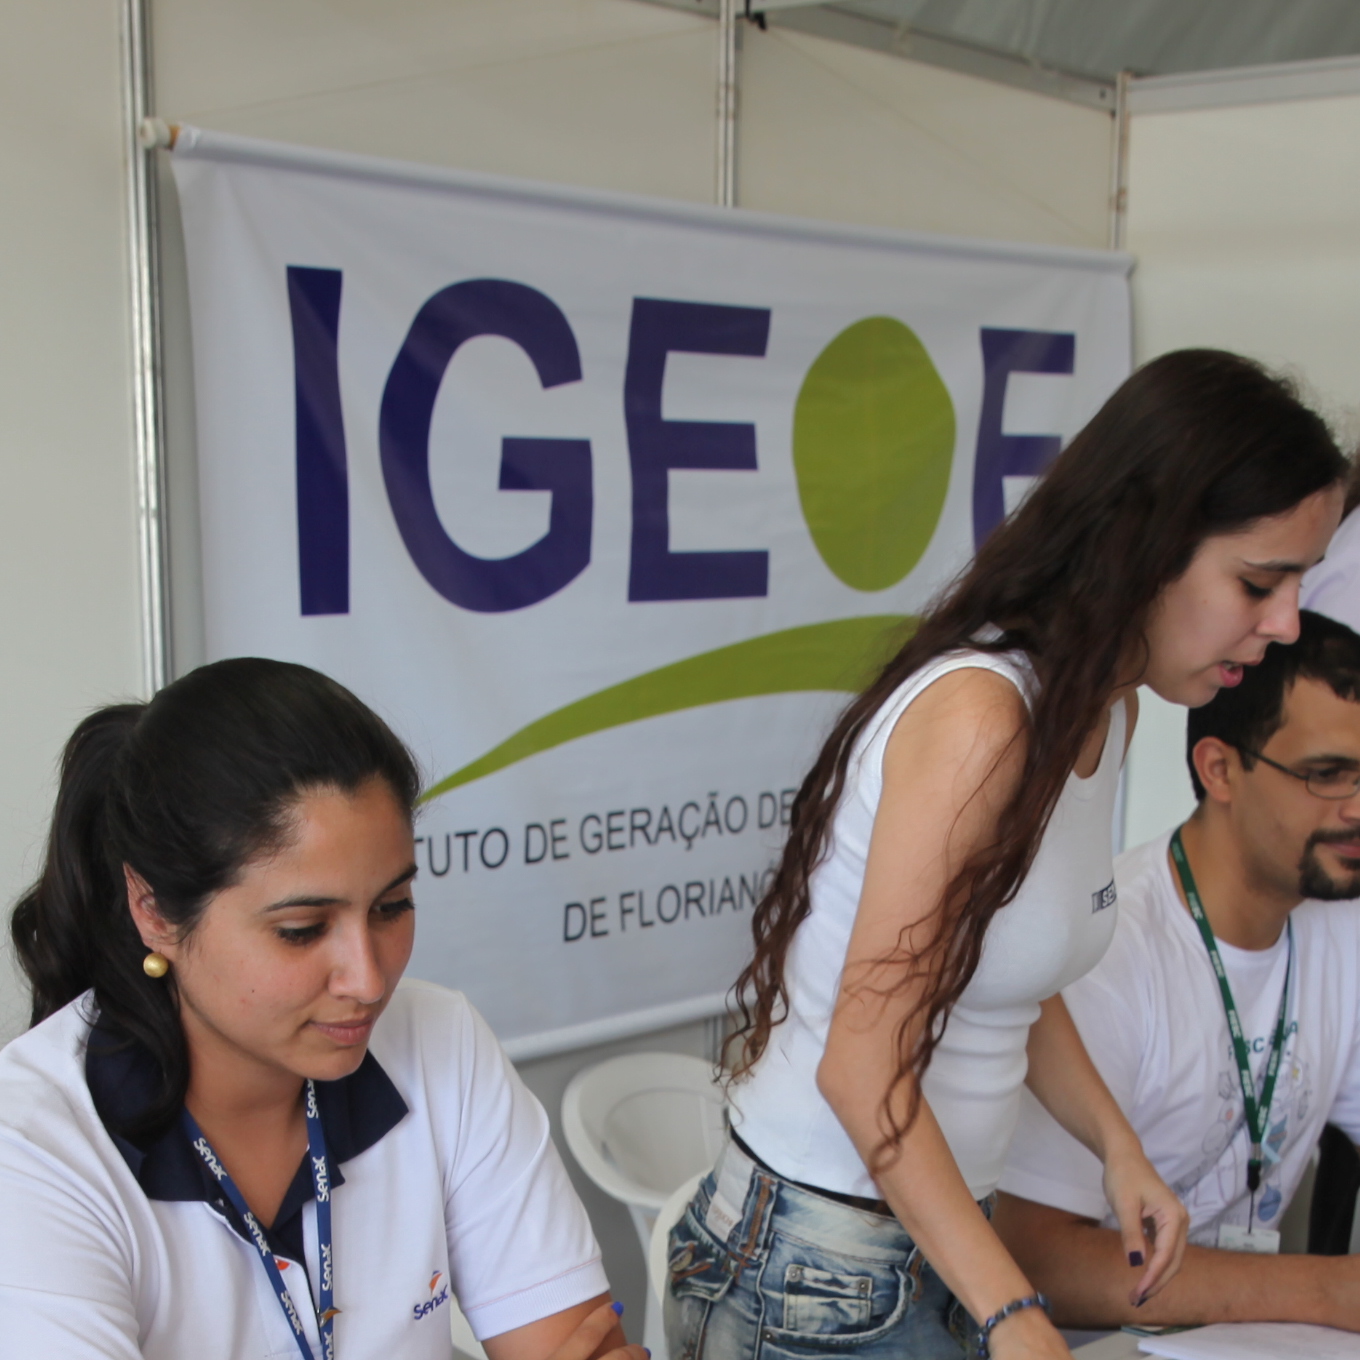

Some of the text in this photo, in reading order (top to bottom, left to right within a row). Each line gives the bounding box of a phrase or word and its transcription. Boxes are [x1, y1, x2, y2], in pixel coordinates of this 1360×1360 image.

[523, 818, 570, 866] DE
[579, 791, 749, 852] GERAÇÃO
[563, 896, 610, 943] DE
